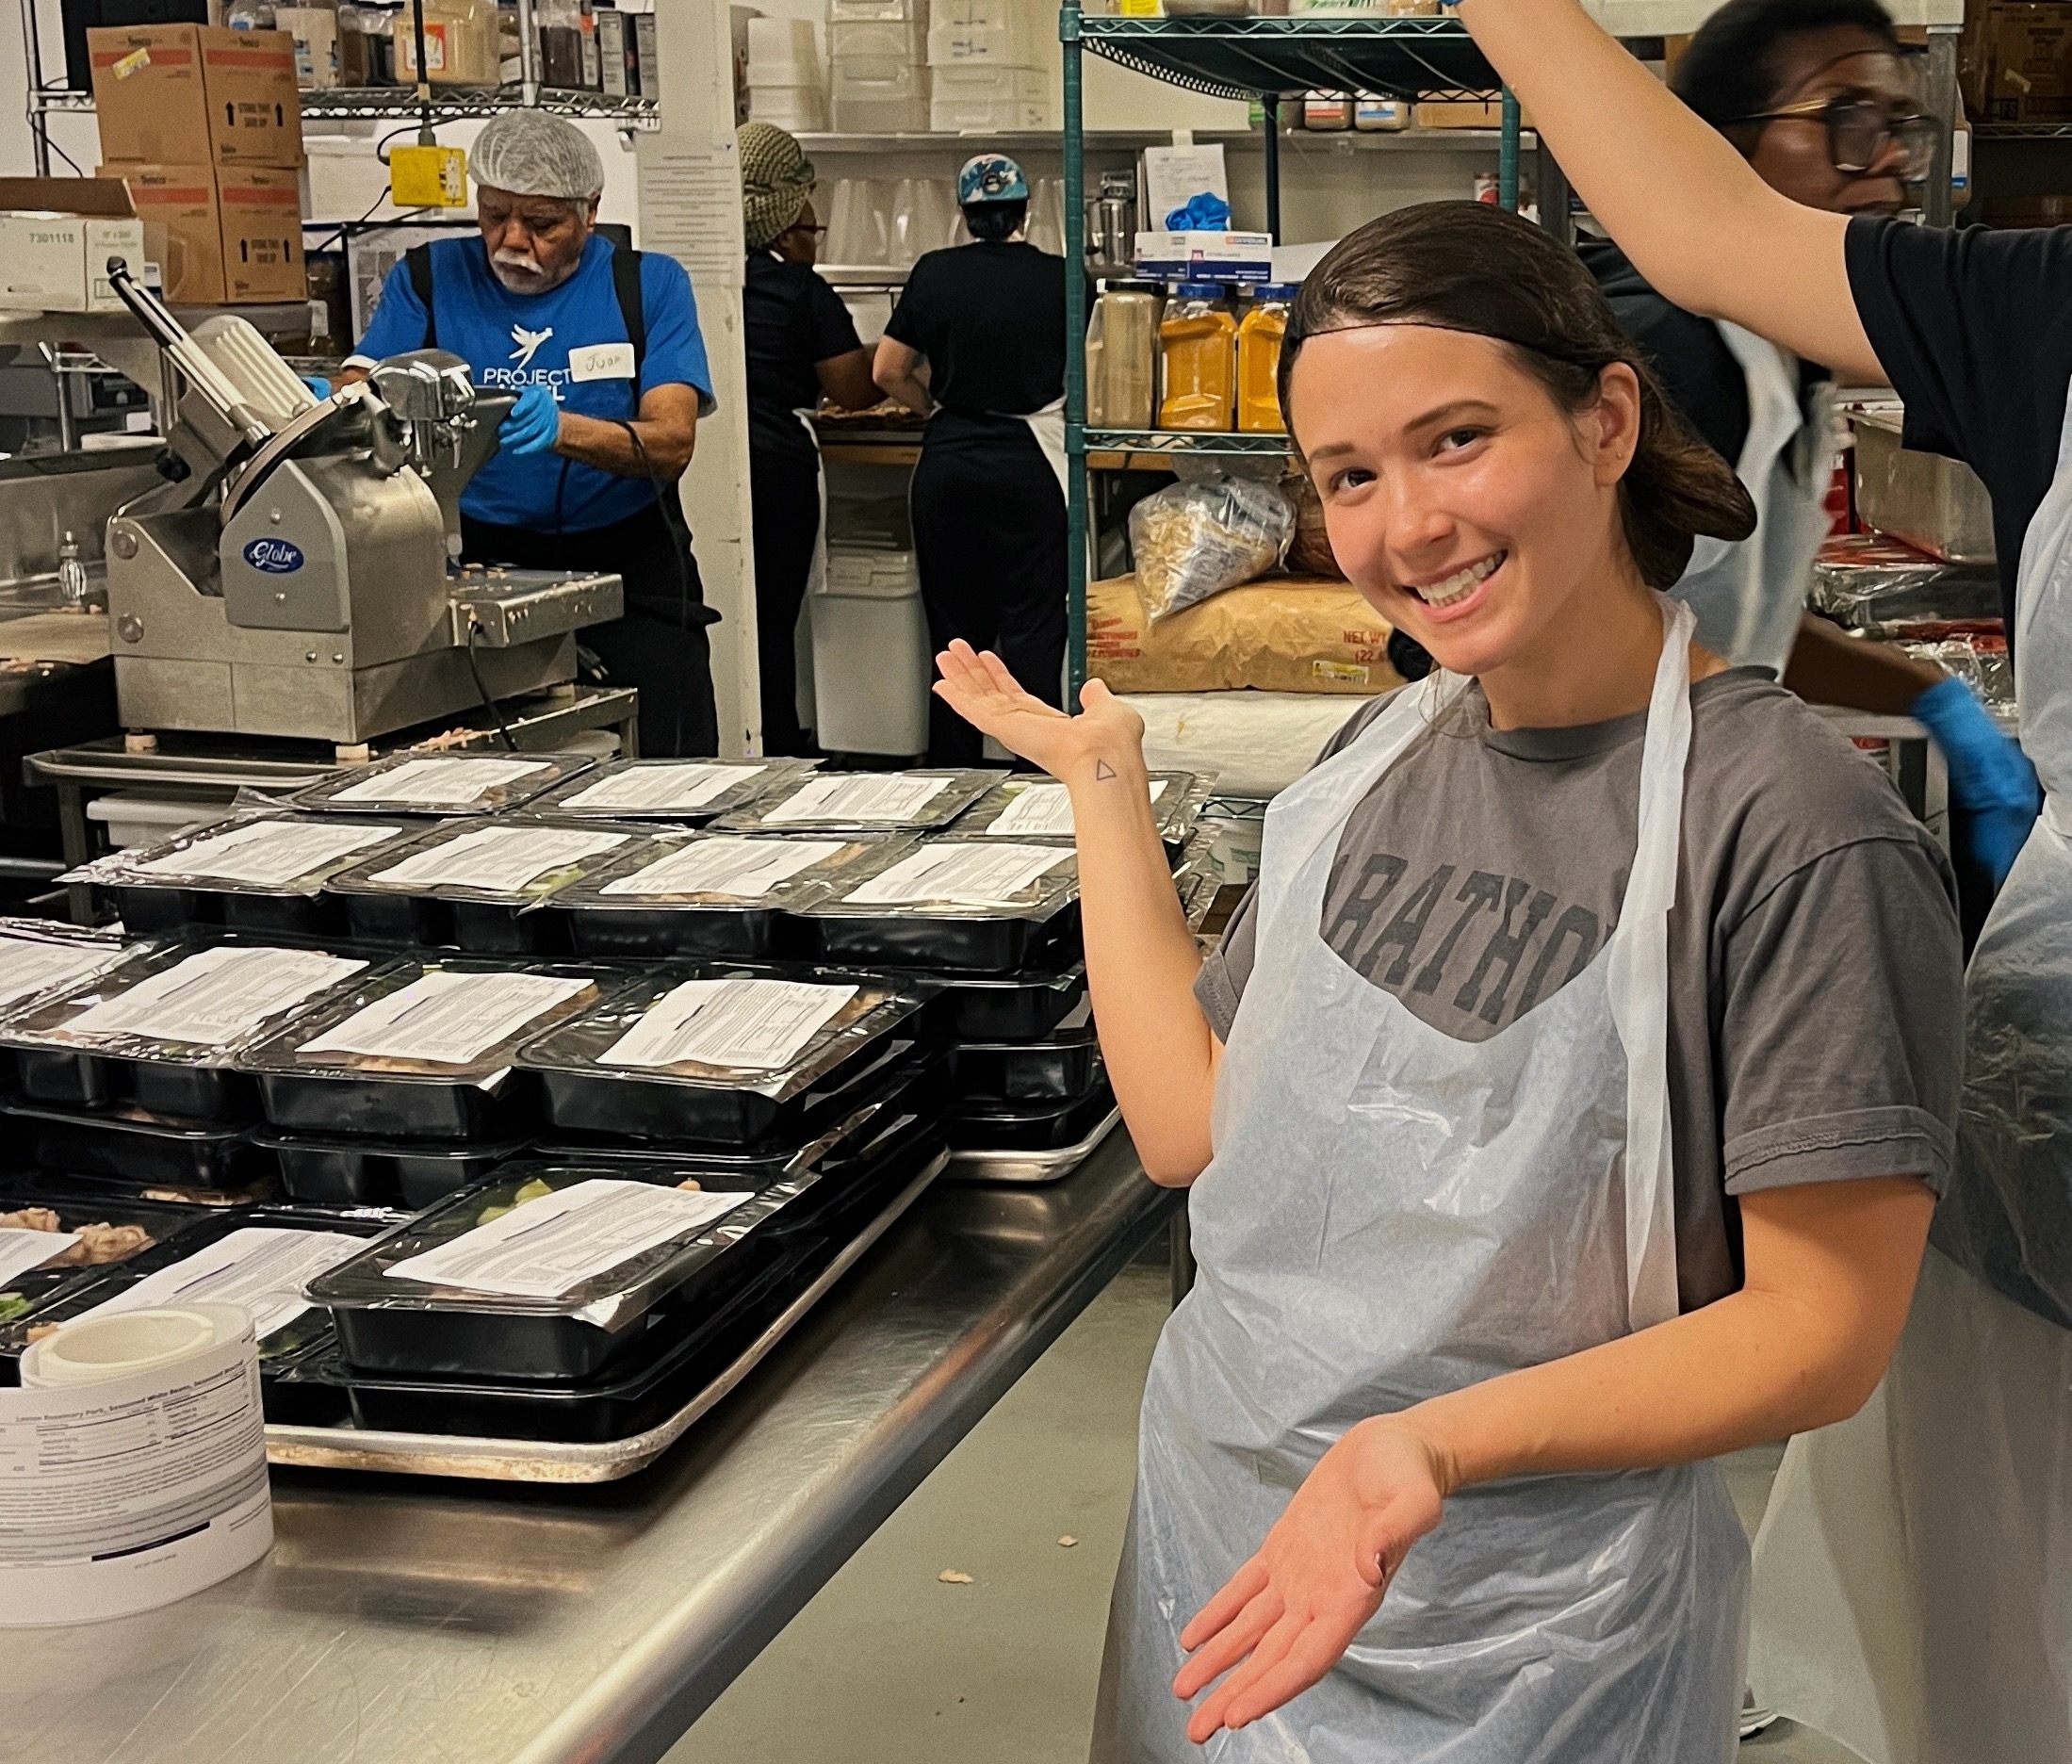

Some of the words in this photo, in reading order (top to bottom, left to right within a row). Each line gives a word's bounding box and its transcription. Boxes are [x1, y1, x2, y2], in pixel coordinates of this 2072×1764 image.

[585, 352, 621, 372] Juan
[483, 368, 571, 385] PROJECT
[249, 541, 297, 568] Globe
[1343, 630, 1364, 644] NET
